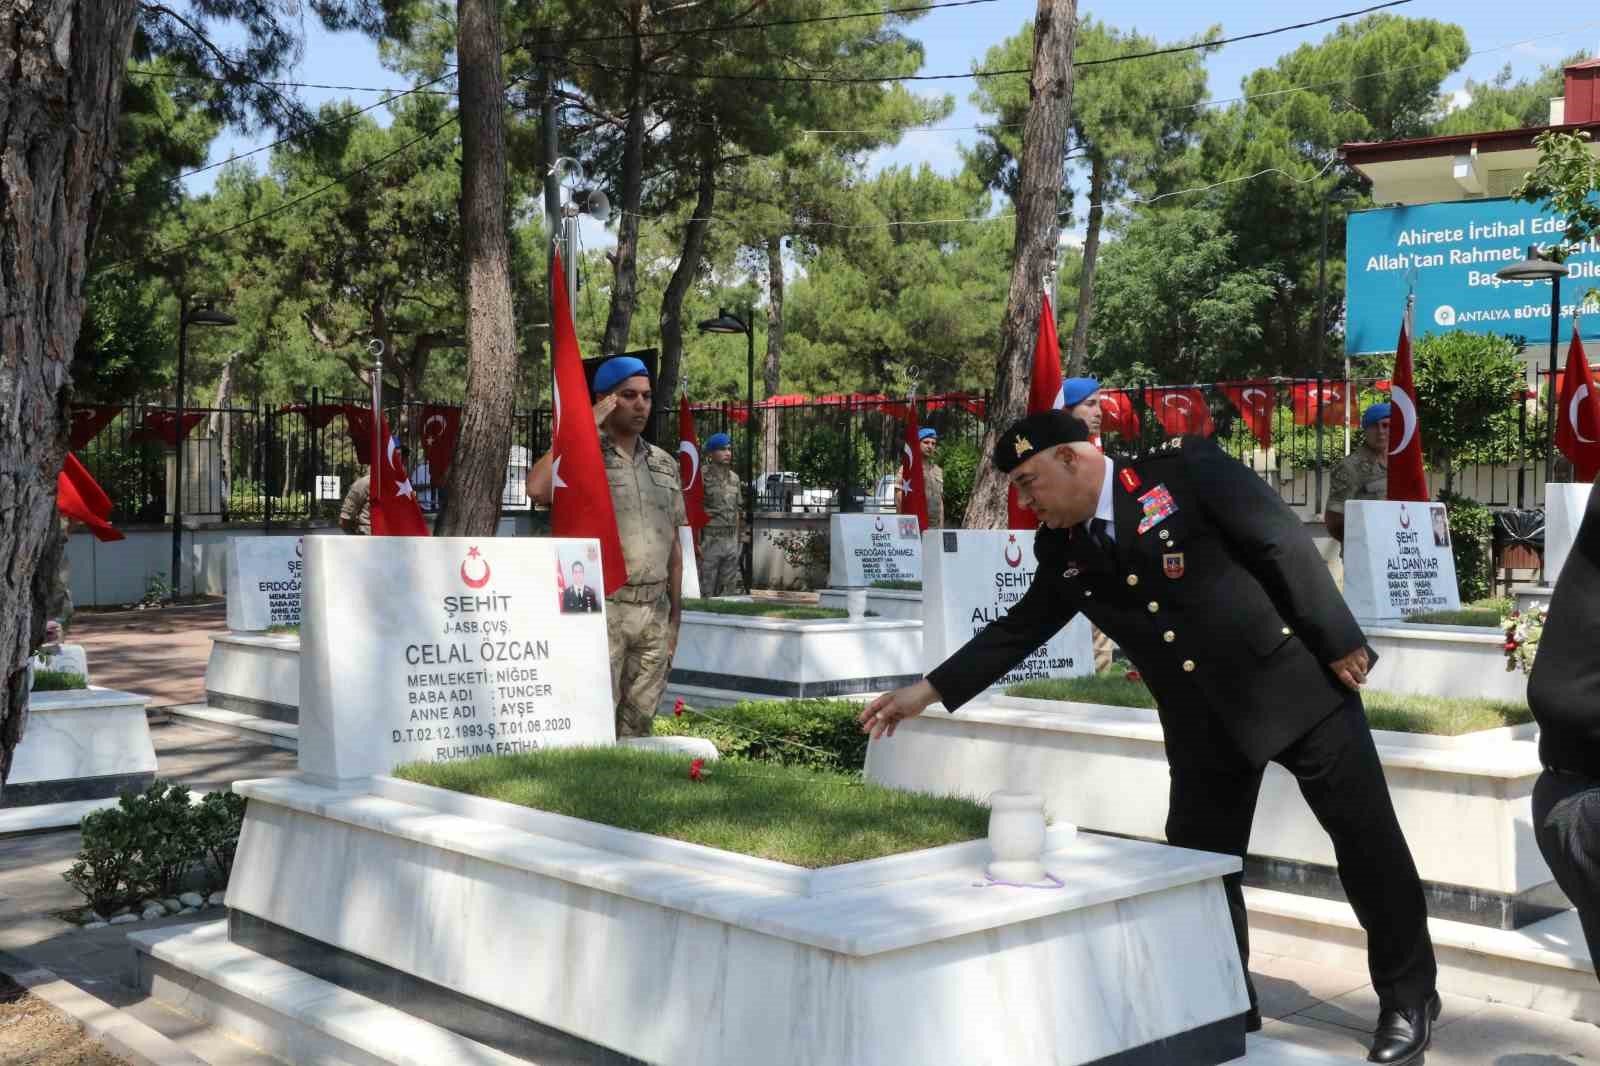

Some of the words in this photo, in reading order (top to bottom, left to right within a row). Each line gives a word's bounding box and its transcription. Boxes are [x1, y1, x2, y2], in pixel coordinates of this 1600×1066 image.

[1398, 226, 1464, 247] Ahirete
[1469, 218, 1525, 240] İrtihal
[1531, 216, 1573, 235] Ede
[1366, 252, 1444, 272] Allah'tan
[1450, 245, 1527, 266] Rahmet,
[1457, 308, 1510, 323] ANTALYA
[1514, 302, 1600, 320] BÜYÜŞEHİR
[995, 568, 1035, 592] ŞEHİT
[444, 591, 512, 618] ŞEHİT
[971, 602, 999, 623] ALİ
[406, 643, 473, 665] CELAL
[480, 637, 549, 662] ÖZCAN
[496, 667, 538, 683] NİĞDE
[408, 691, 447, 704] BABA
[450, 689, 472, 702] ADI
[498, 684, 553, 699] TUNCER
[409, 707, 448, 722] ANNE
[452, 705, 476, 718] ADI
[500, 702, 535, 718] AYŞE
[436, 743, 494, 761] RUHUNA
[496, 739, 539, 756] FATİHA
